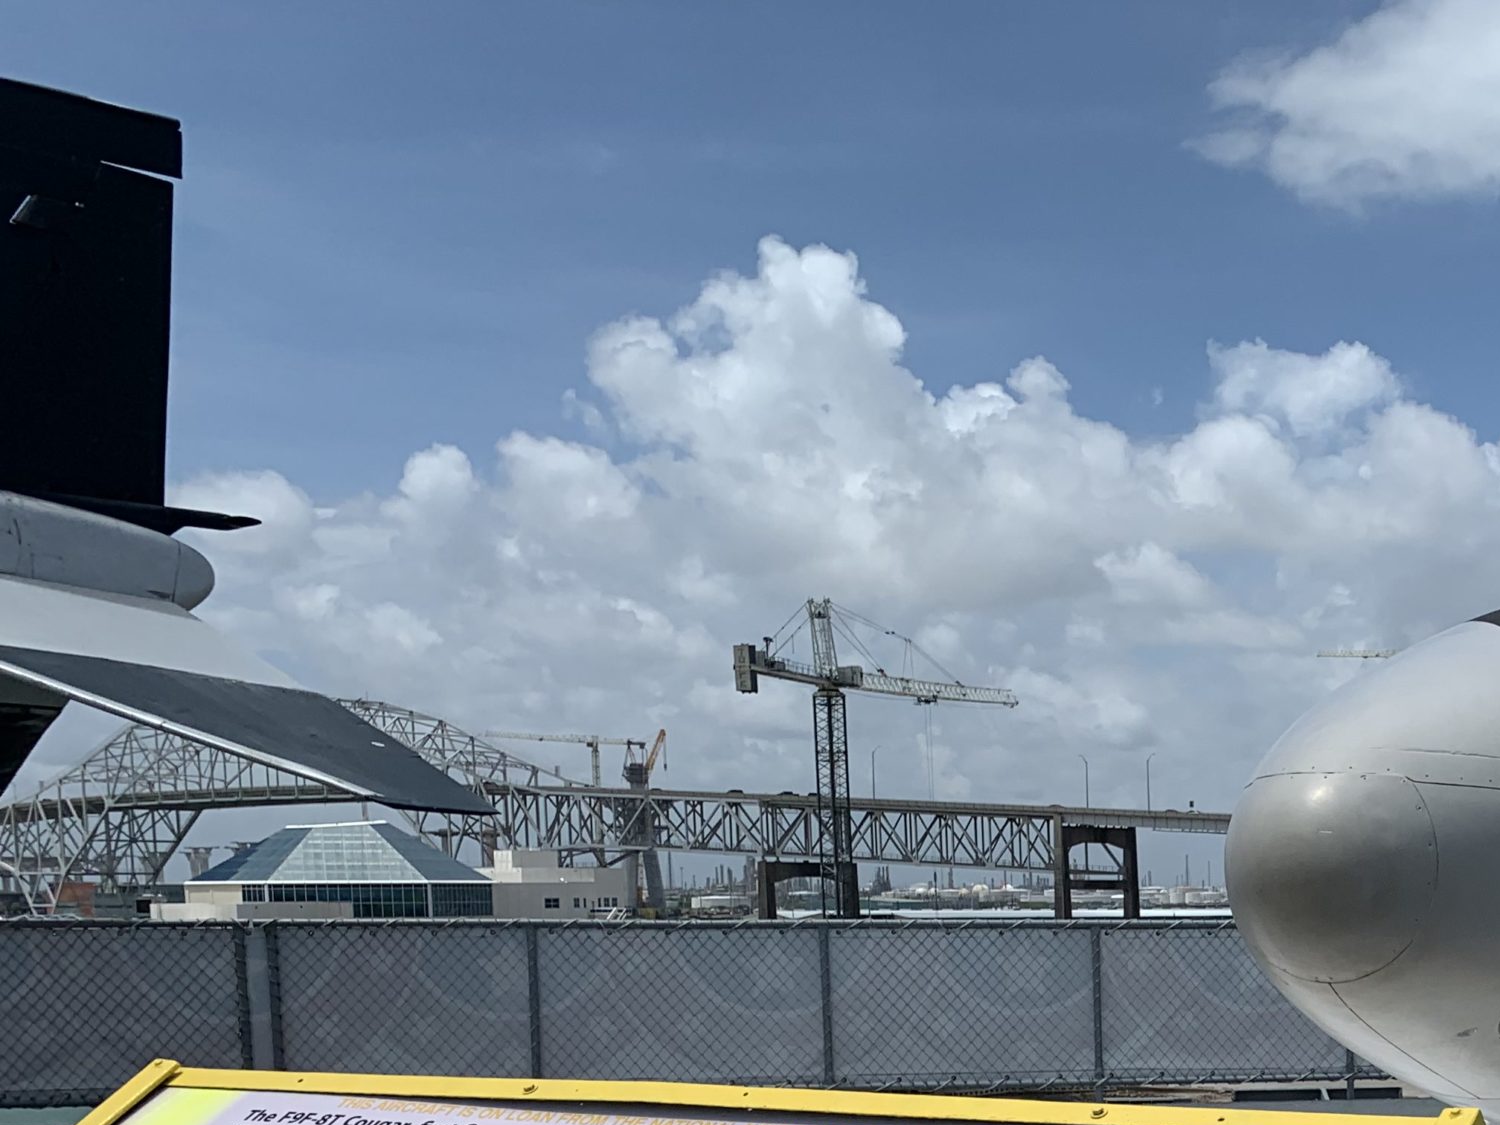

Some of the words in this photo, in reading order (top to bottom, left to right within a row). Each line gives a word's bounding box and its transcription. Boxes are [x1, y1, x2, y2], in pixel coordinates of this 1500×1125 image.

[243, 1108, 278, 1123] The
[341, 1095, 376, 1109] THIS
[377, 1100, 460, 1114] AIRCRAFT
[457, 1105, 477, 1117] IS
[477, 1107, 507, 1120] ON
[506, 1109, 556, 1122] LOAN
[557, 1112, 610, 1125] FROM
